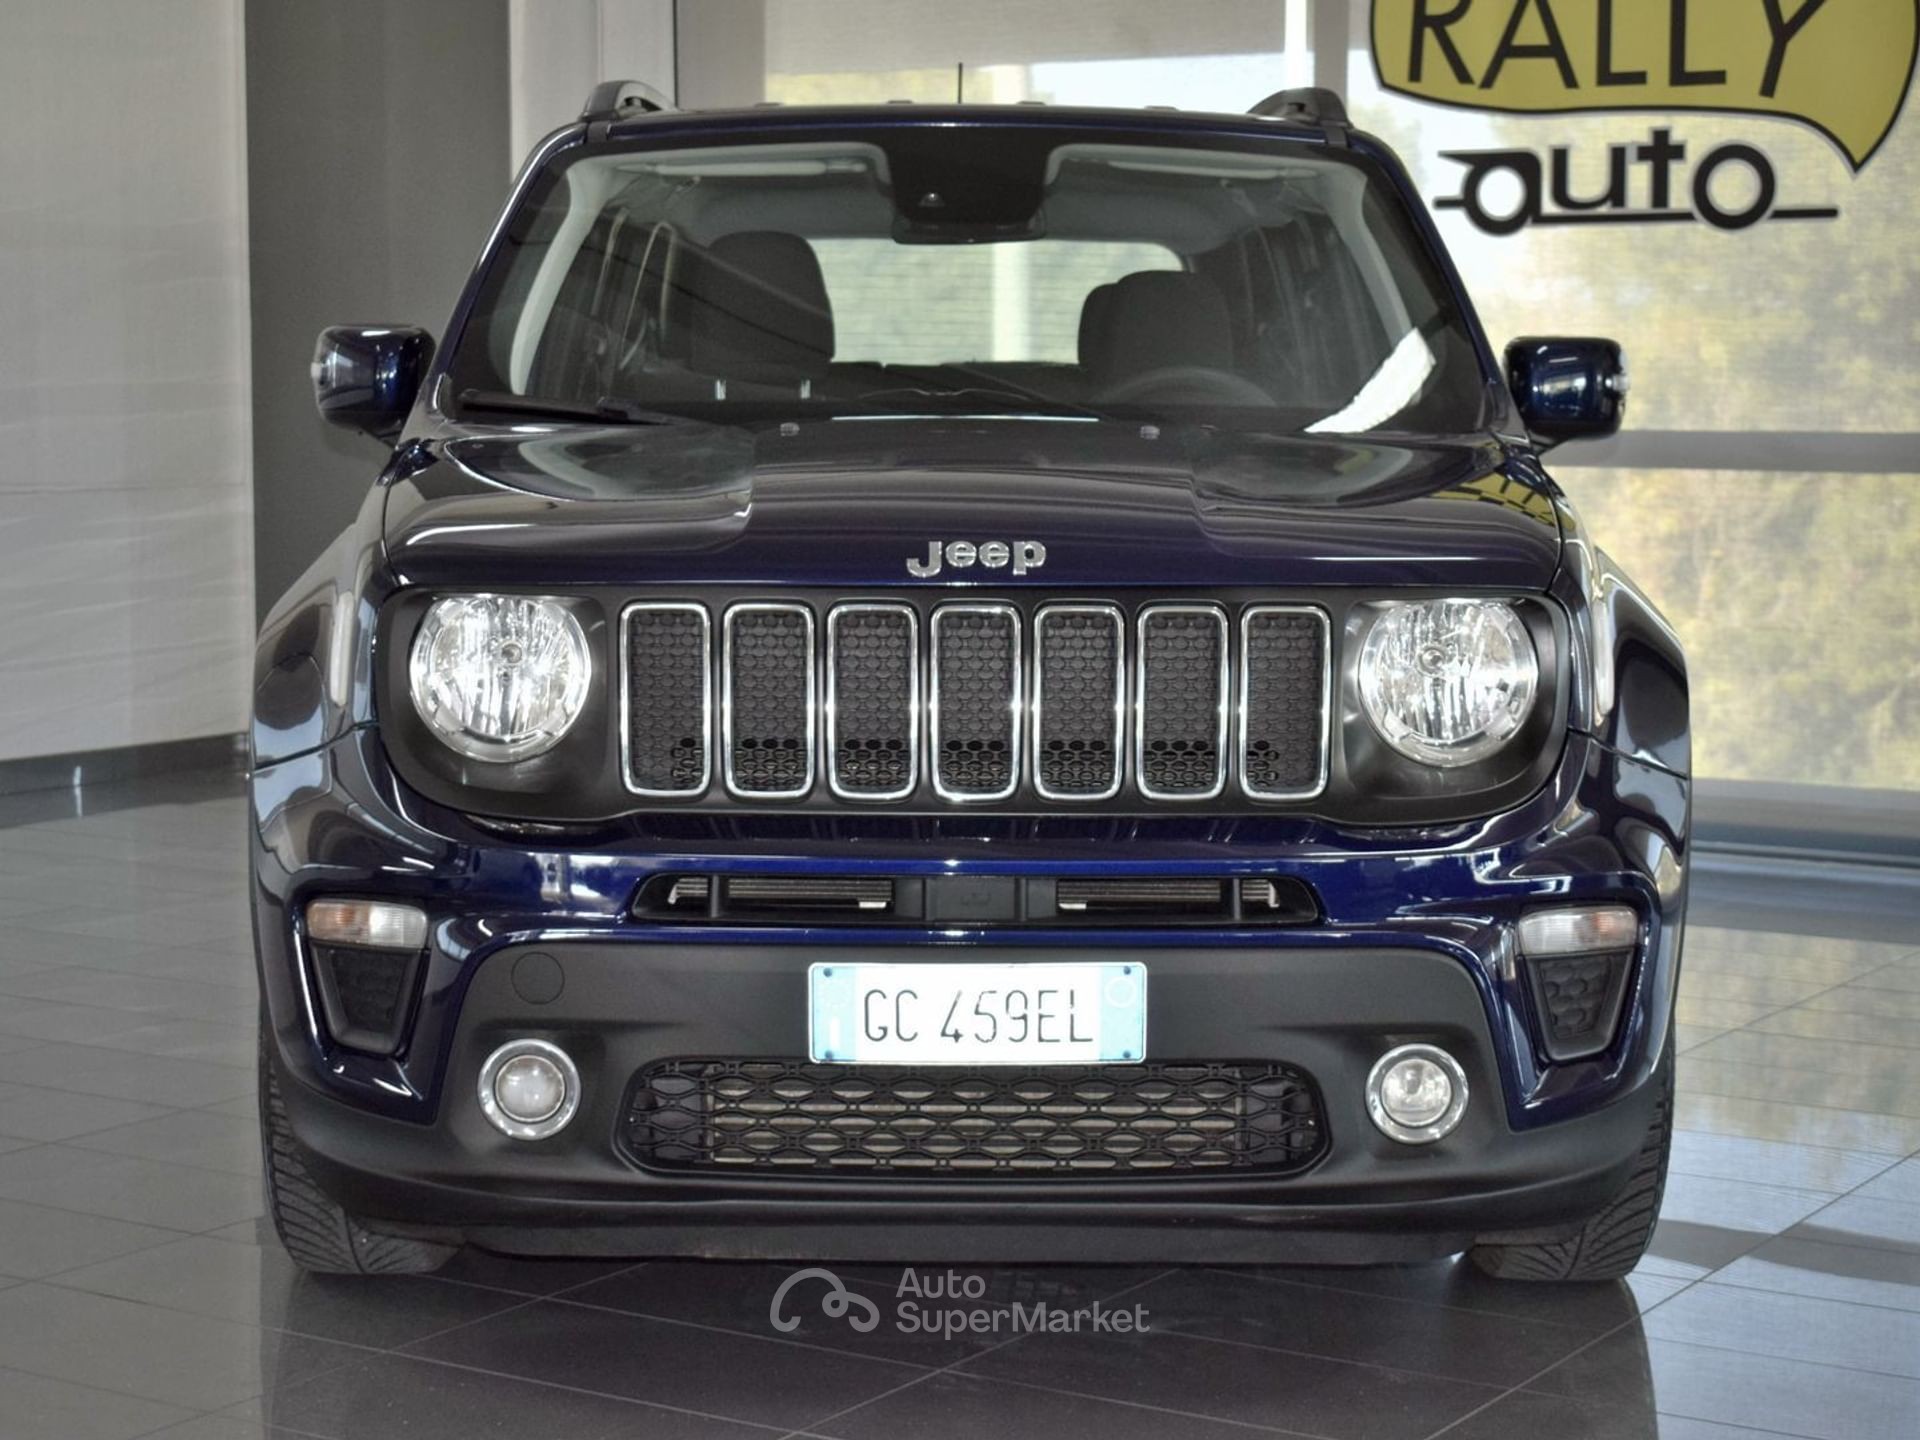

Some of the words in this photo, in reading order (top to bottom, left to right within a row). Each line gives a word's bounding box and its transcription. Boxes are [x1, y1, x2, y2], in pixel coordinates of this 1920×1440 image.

[1408, 0, 1827, 98] RALLY
[1437, 127, 1777, 237] auto
[906, 540, 1047, 578] Jeep
[864, 989, 919, 1043] GC
